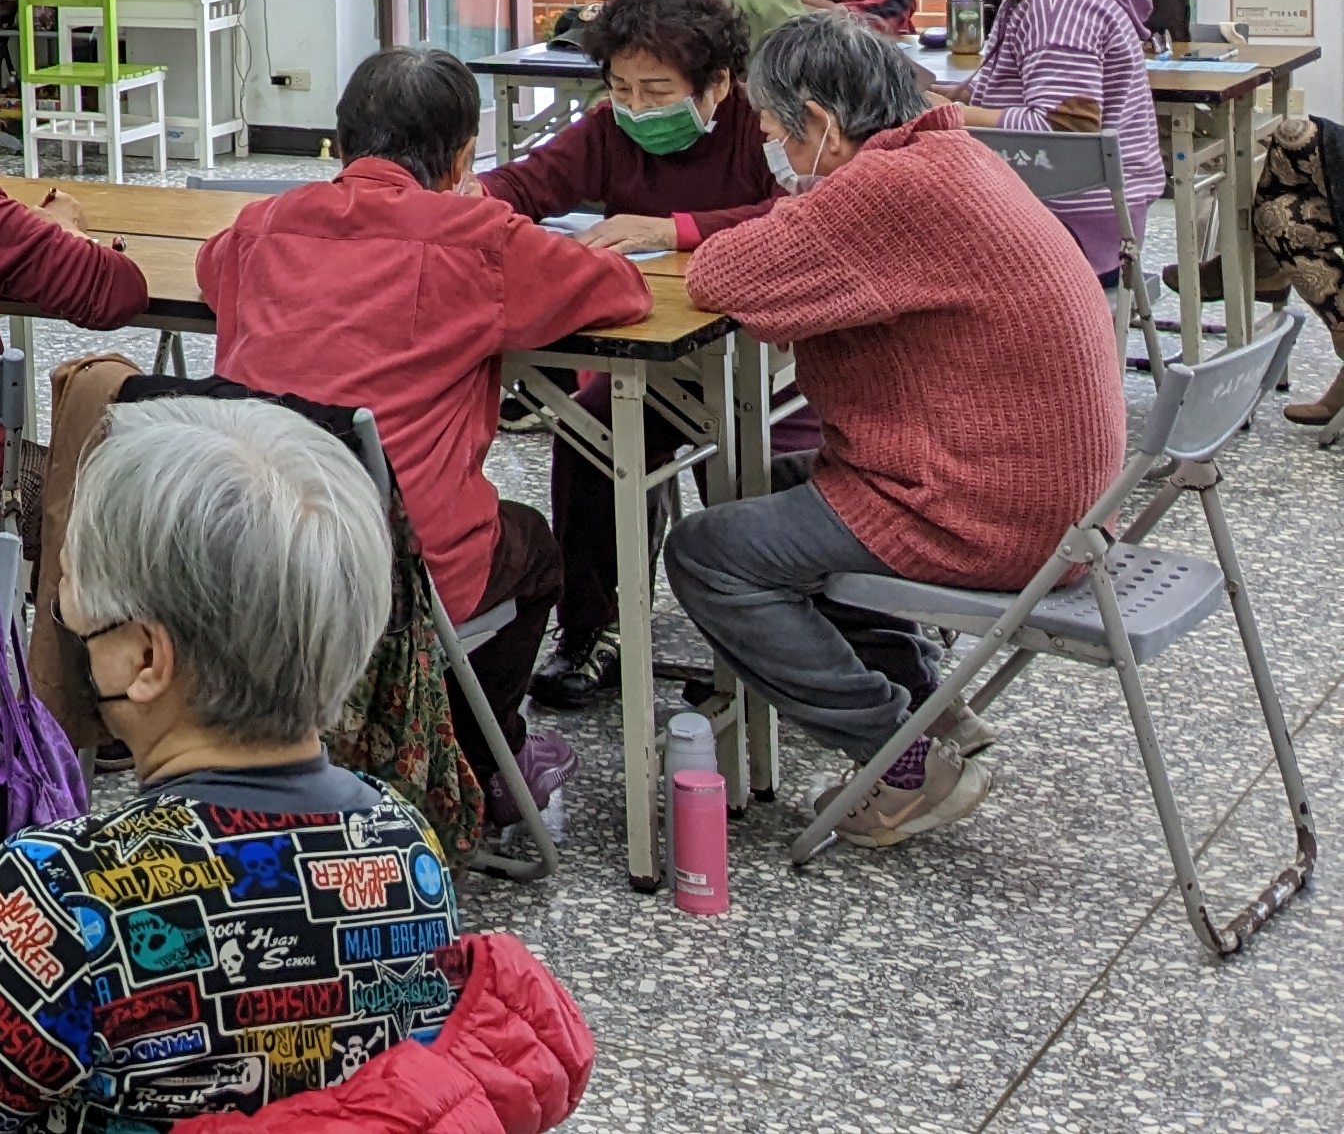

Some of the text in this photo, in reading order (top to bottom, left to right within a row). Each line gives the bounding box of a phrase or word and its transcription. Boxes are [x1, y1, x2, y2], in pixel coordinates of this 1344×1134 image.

[208, 803, 342, 835] CRUS
[312, 855, 400, 888] BREAKER
[342, 877, 386, 909] MAD
[345, 919, 446, 961] MAD BREAKER
[235, 981, 343, 1026] CRUSHED
